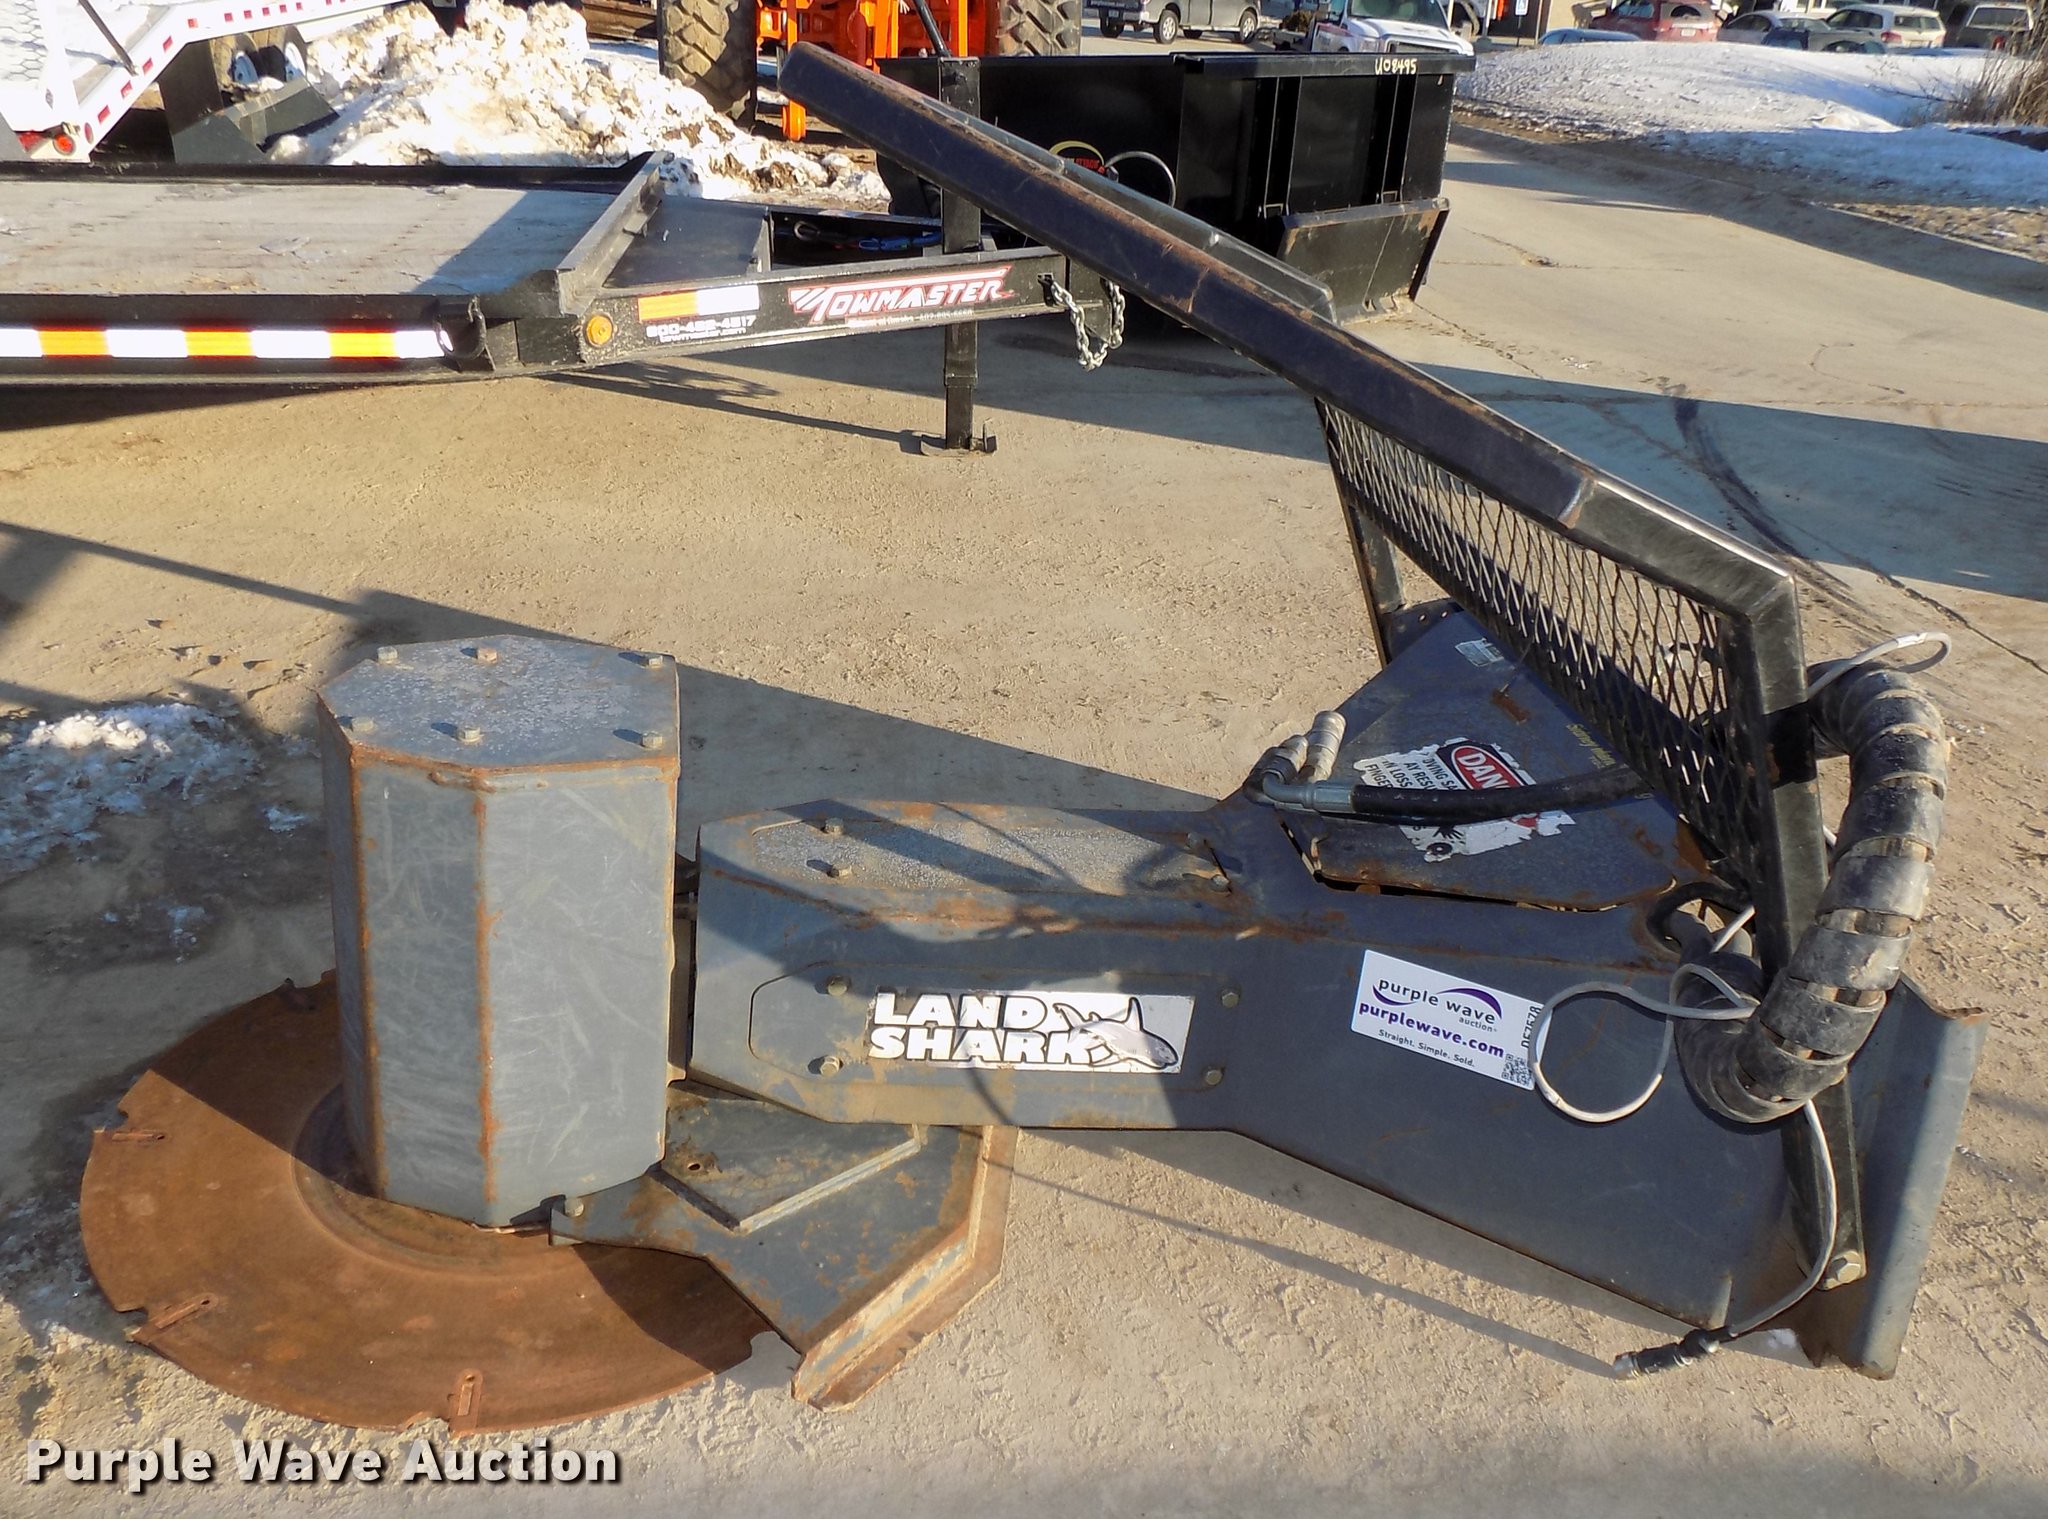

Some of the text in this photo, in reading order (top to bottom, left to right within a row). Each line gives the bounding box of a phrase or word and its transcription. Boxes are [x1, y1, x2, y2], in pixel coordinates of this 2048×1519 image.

[789, 266, 1014, 324] TOWMASTER
[1390, 766, 1414, 788] LOSS
[873, 992, 1047, 1030] LAND
[1378, 978, 1496, 1024] purple wave
[1359, 1002, 1504, 1058] purplewave.com
[1459, 1017, 1493, 1032] auction
[869, 1026, 1106, 1066] SHARK
[1378, 1029, 1475, 1067] Straight. Simple. Sold.
